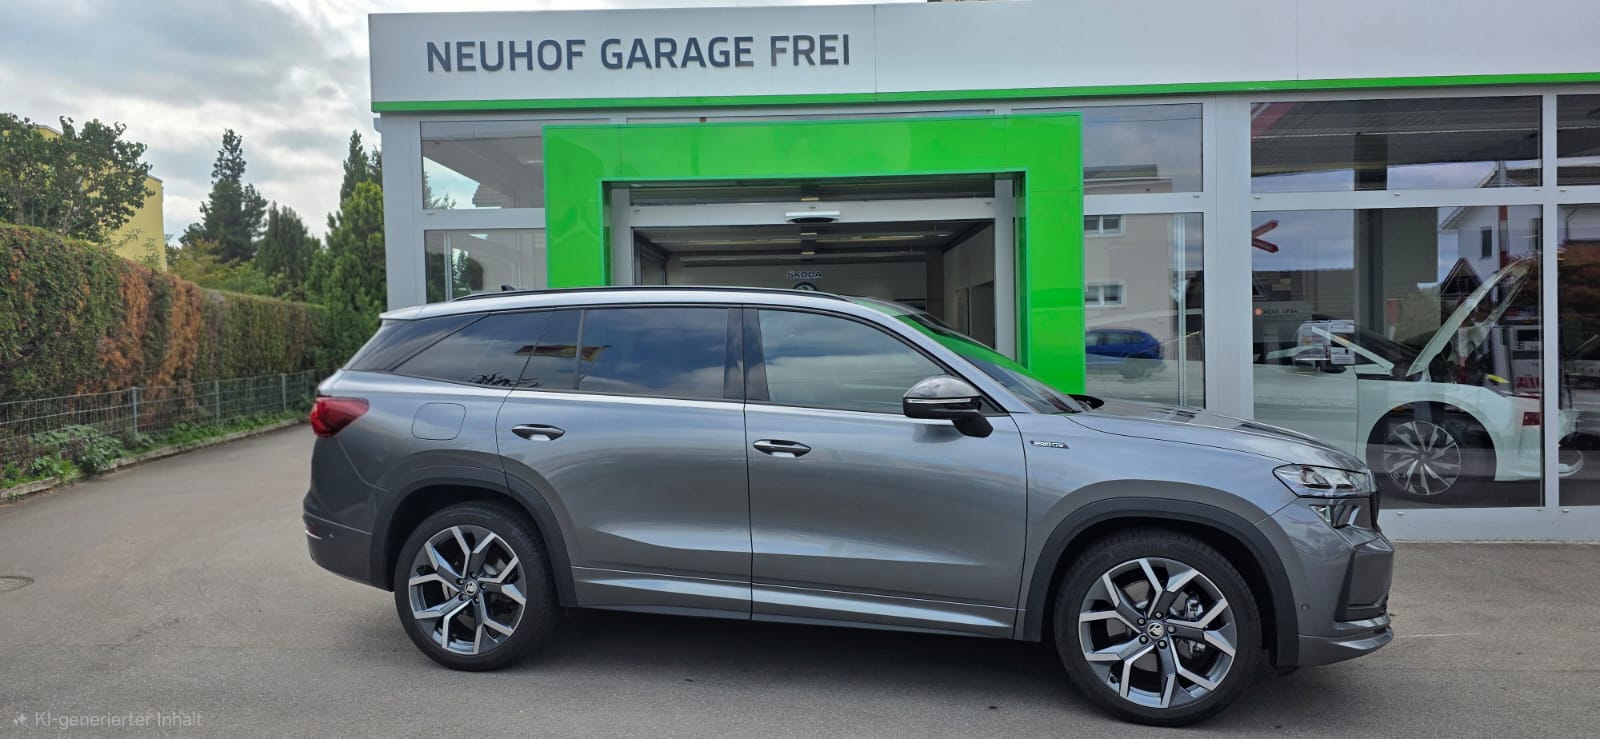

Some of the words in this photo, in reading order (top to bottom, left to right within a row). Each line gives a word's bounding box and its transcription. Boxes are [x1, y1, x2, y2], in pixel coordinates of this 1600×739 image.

[426, 39, 586, 72] NEUHOF
[600, 36, 754, 70] GARAGE
[769, 34, 850, 66] FREI
